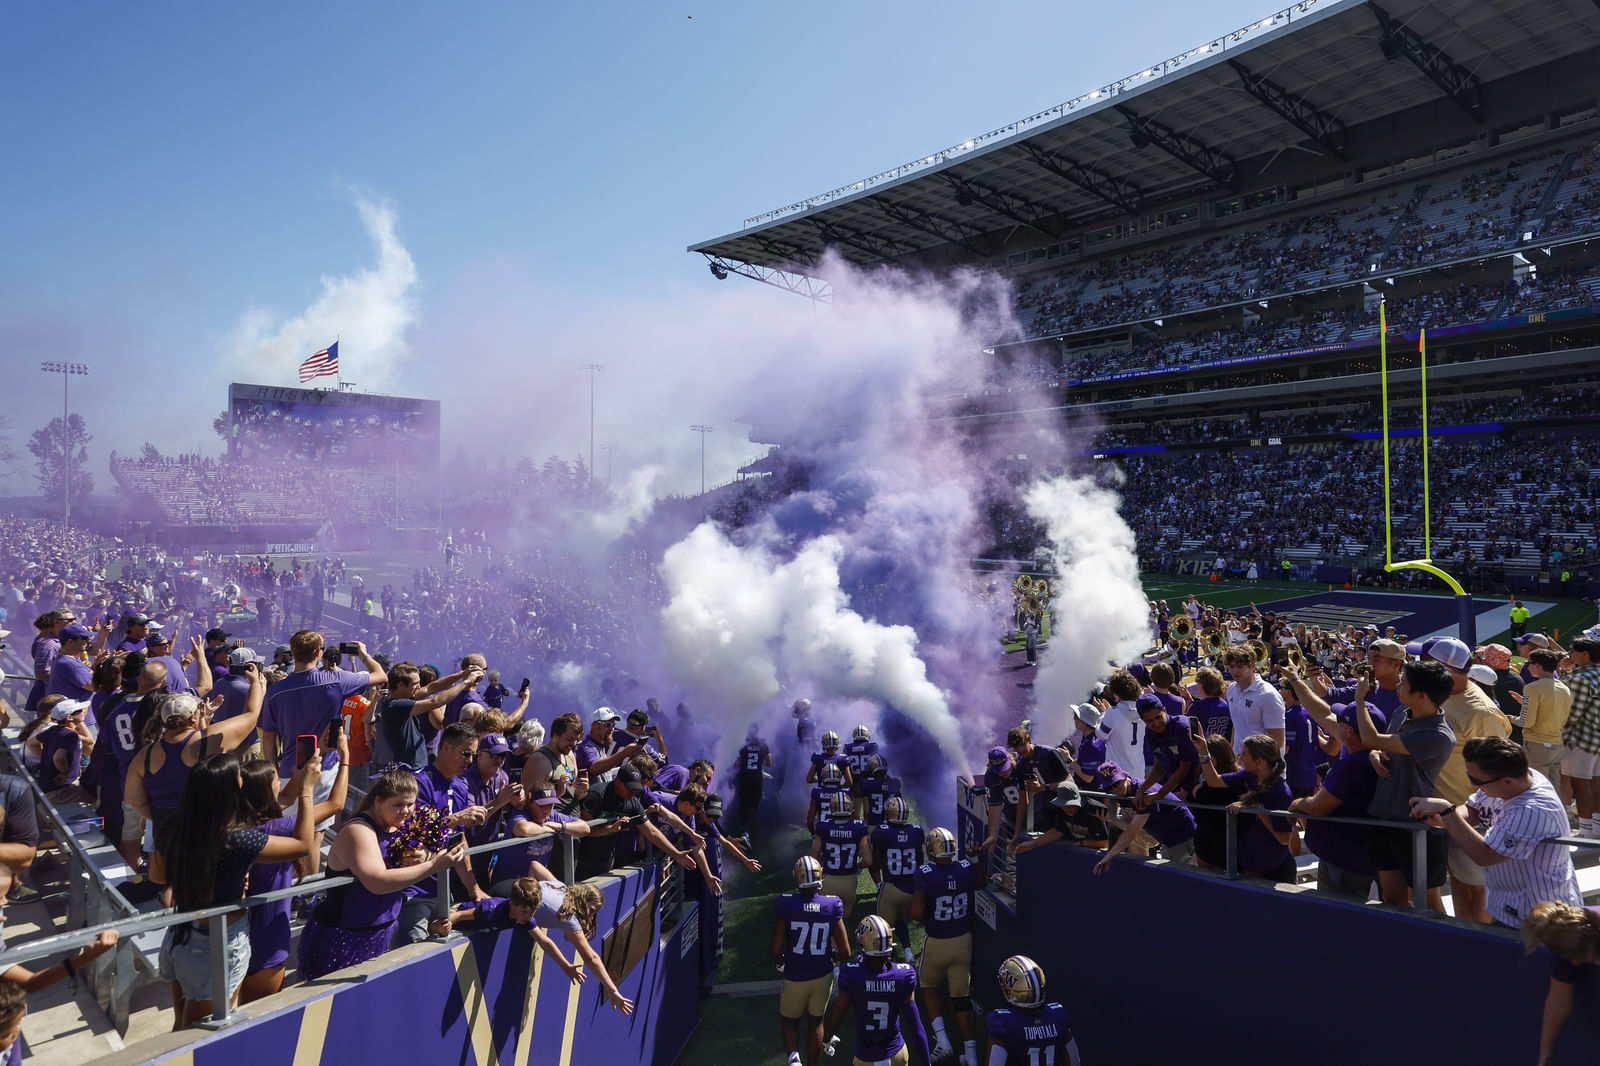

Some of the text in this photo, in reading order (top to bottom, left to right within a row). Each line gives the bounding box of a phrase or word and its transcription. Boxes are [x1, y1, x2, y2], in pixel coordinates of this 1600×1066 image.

[1528, 313, 1546, 324] ONE
[256, 387, 327, 402] HUSKY
[1250, 437, 1282, 447] ONE GOAL
[1177, 559, 1218, 576] KIE
[1245, 699, 1254, 708] W
[1130, 721, 1139, 745] 1
[1305, 718, 1313, 744] 1
[746, 752, 760, 770] 2
[543, 788, 553, 798] W
[830, 829, 853, 839] WESTOVER
[825, 842, 857, 870] 37
[886, 847, 917, 876] 83
[948, 880, 958, 890] ALE
[934, 892, 969, 921] 68
[790, 920, 831, 956] 70
[865, 980, 897, 993] WILLIAMS
[1004, 972, 1019, 989] W
[865, 1000, 890, 1031] 3
[1023, 1023, 1059, 1041] TUPUTALA
[1026, 1044, 1056, 1066] 11
